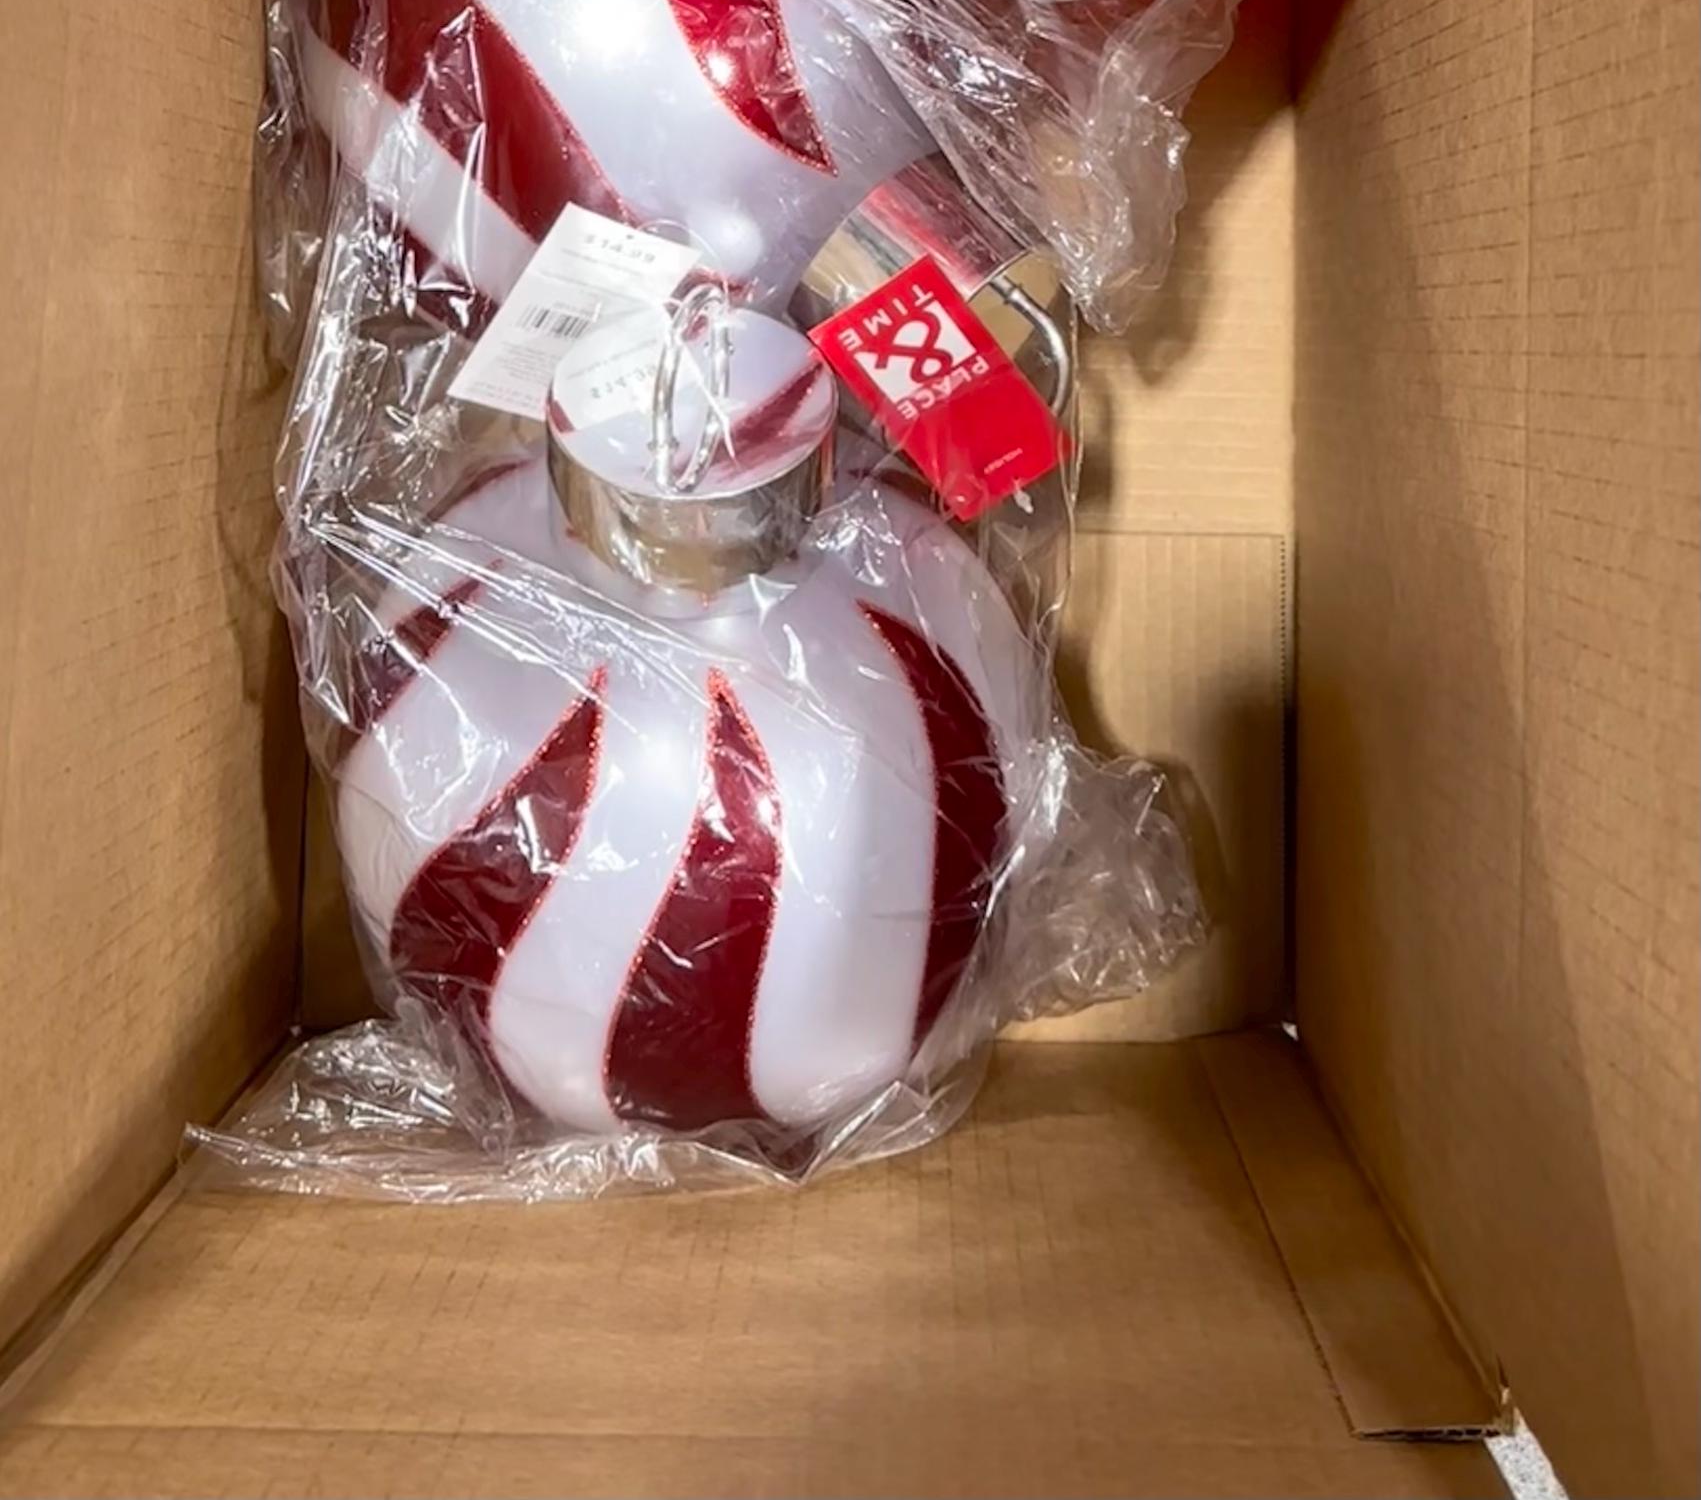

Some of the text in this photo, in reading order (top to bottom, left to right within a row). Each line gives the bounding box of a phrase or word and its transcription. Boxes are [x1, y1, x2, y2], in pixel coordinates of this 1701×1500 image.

[838, 284, 933, 351] TIME
[857, 302, 965, 396] &
[897, 355, 990, 420] PLACE
